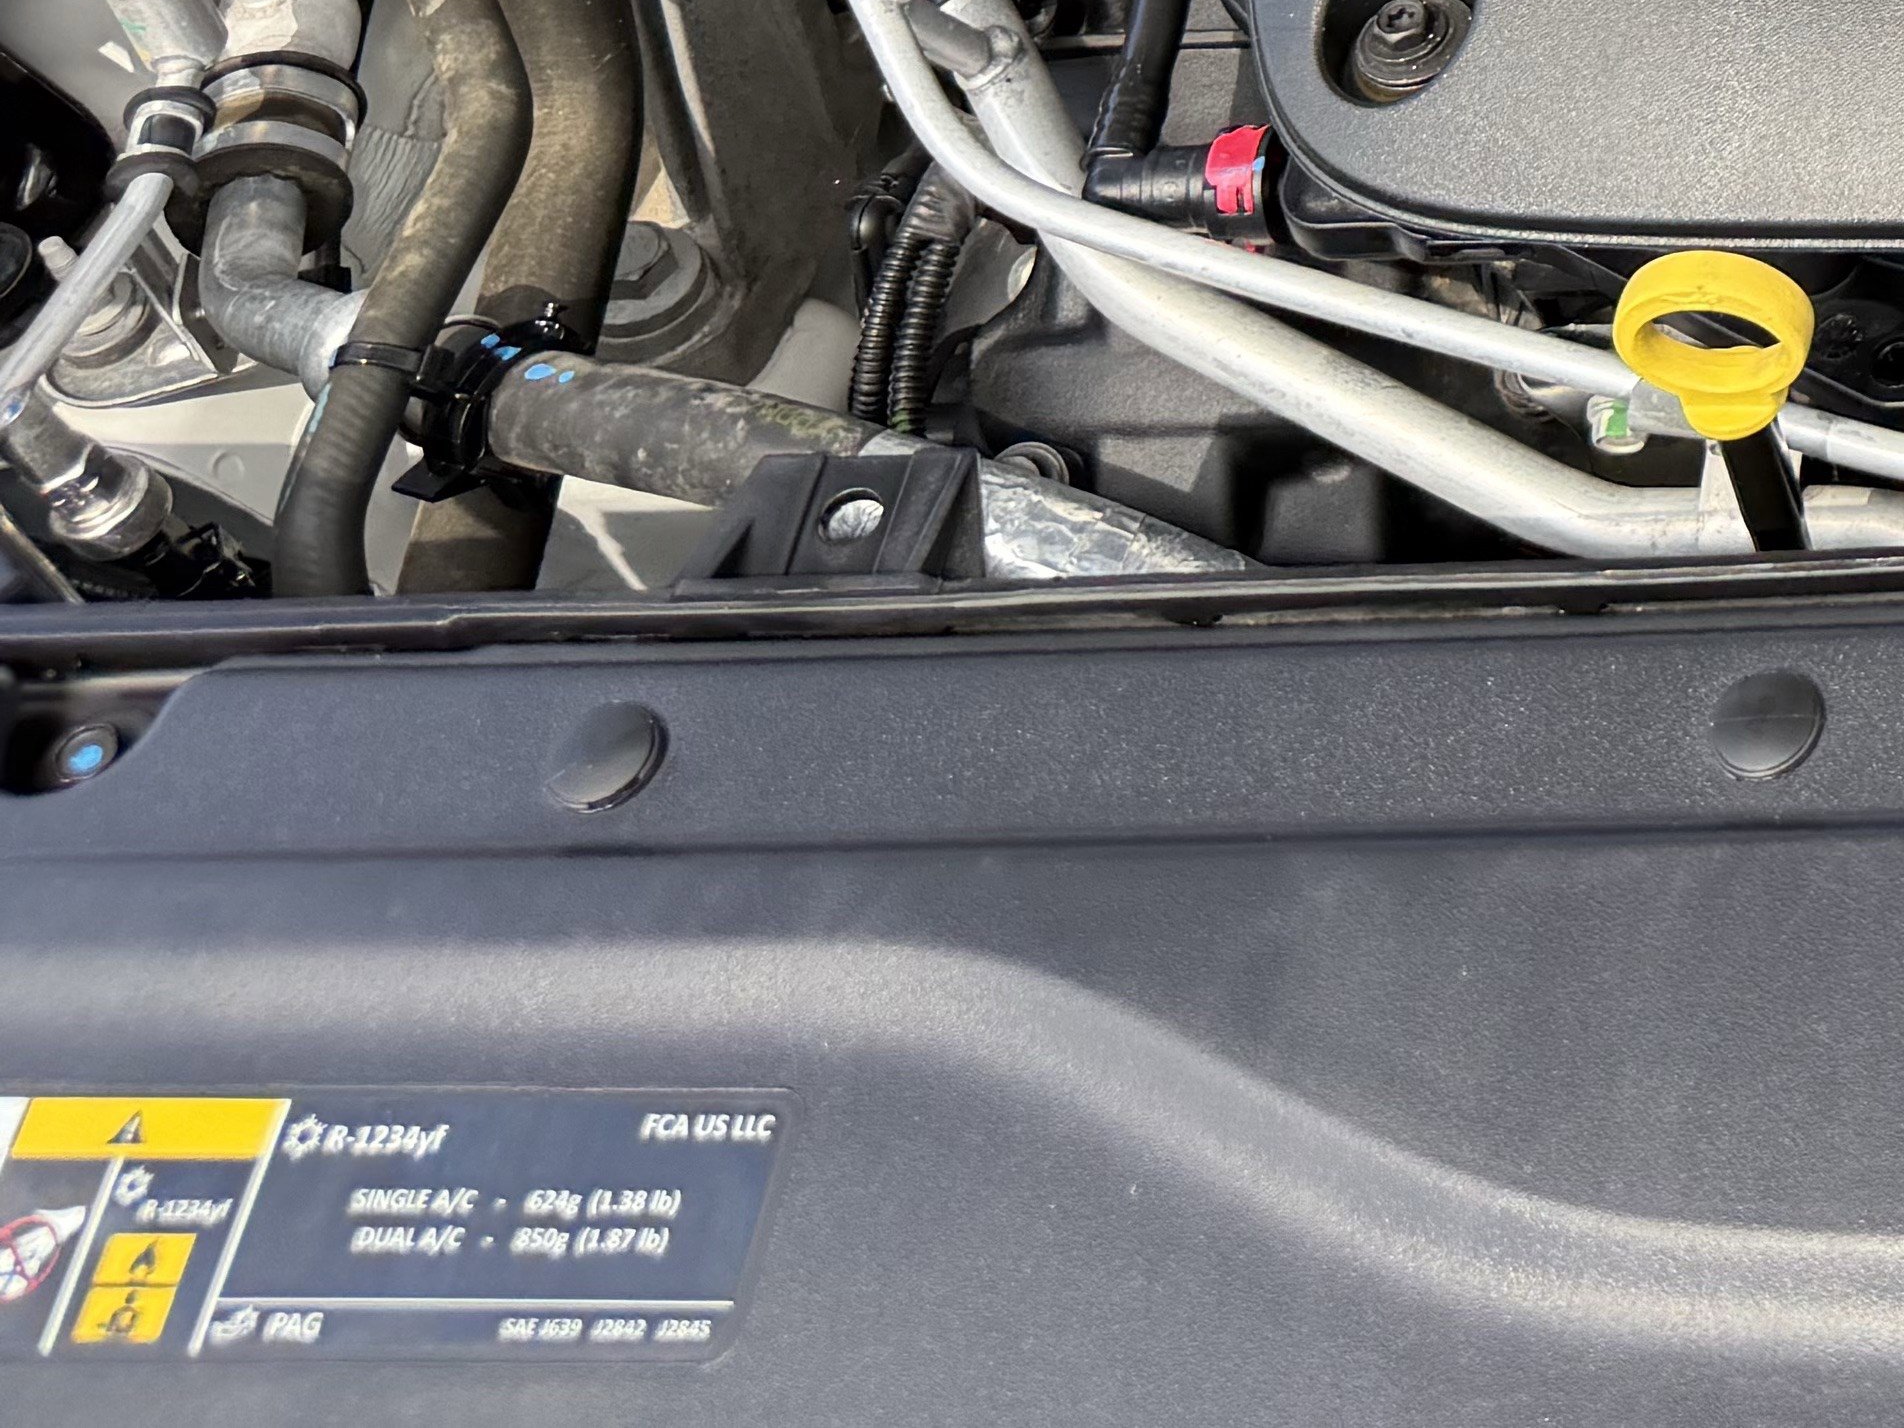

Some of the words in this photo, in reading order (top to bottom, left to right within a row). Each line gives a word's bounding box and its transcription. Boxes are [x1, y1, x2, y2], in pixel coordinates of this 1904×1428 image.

[325, 1121, 447, 1161] R-1234yf
[642, 1113, 690, 1140] FCA
[694, 1113, 730, 1140] US
[731, 1114, 777, 1140] LLC
[351, 1188, 430, 1216] SINGLE
[434, 1188, 478, 1217] A/C
[523, 1189, 582, 1221] 624g
[587, 1188, 643, 1218] (1.38
[647, 1188, 681, 1218] lb)
[351, 1226, 414, 1253] DUAL
[417, 1226, 465, 1254] A/C
[510, 1227, 569, 1257] 850g
[574, 1226, 632, 1256] (1.87
[636, 1226, 670, 1256] lb)
[264, 1311, 322, 1339] PAG
[499, 1317, 537, 1339] SAE
